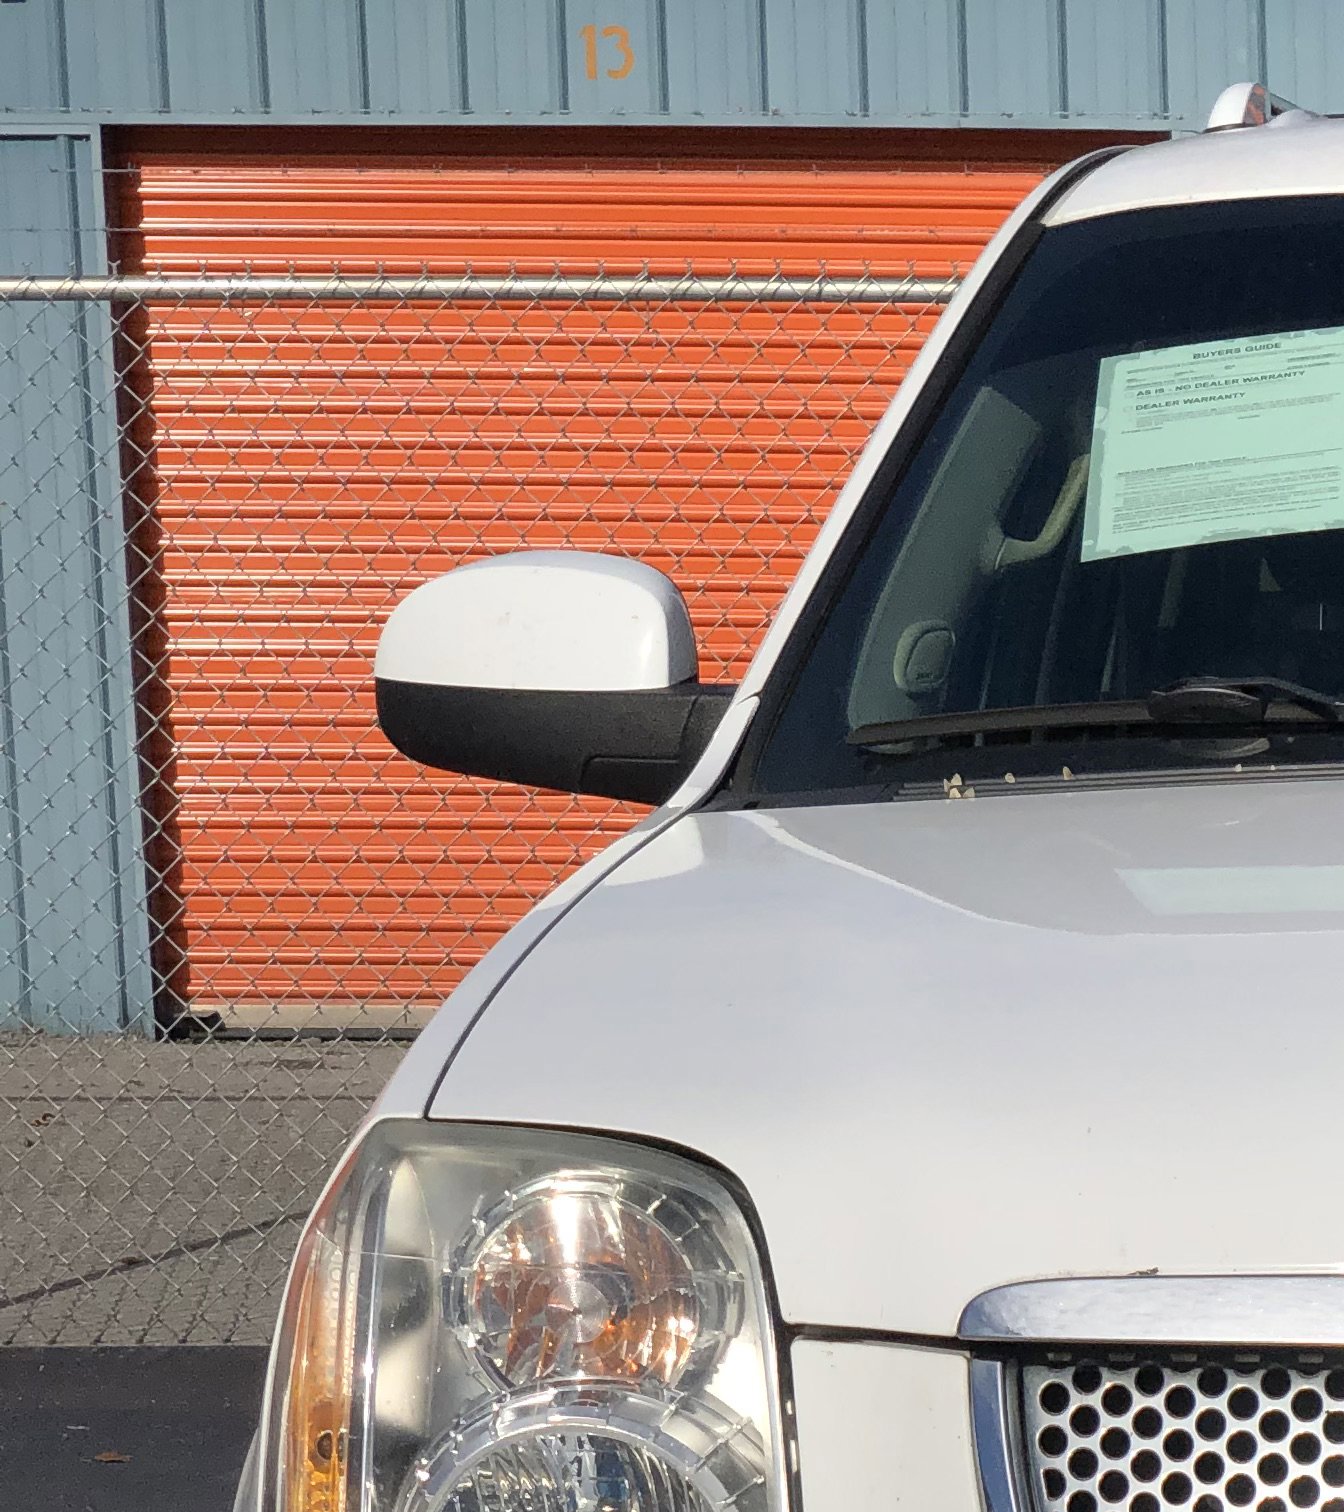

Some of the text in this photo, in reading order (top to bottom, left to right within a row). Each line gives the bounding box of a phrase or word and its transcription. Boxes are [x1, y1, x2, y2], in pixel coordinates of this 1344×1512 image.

[579, 24, 634, 80] 13
[1192, 347, 1241, 360] BUYERS
[1244, 342, 1282, 353] GUIDE
[1136, 389, 1152, 397] AS
[1154, 387, 1165, 395] IS
[1174, 383, 1192, 392] NO
[1194, 378, 1240, 389] DEALER
[1242, 370, 1306, 384] WARRANTY
[1135, 399, 1180, 411] DEALER
[1182, 391, 1246, 405] WARRANTY
